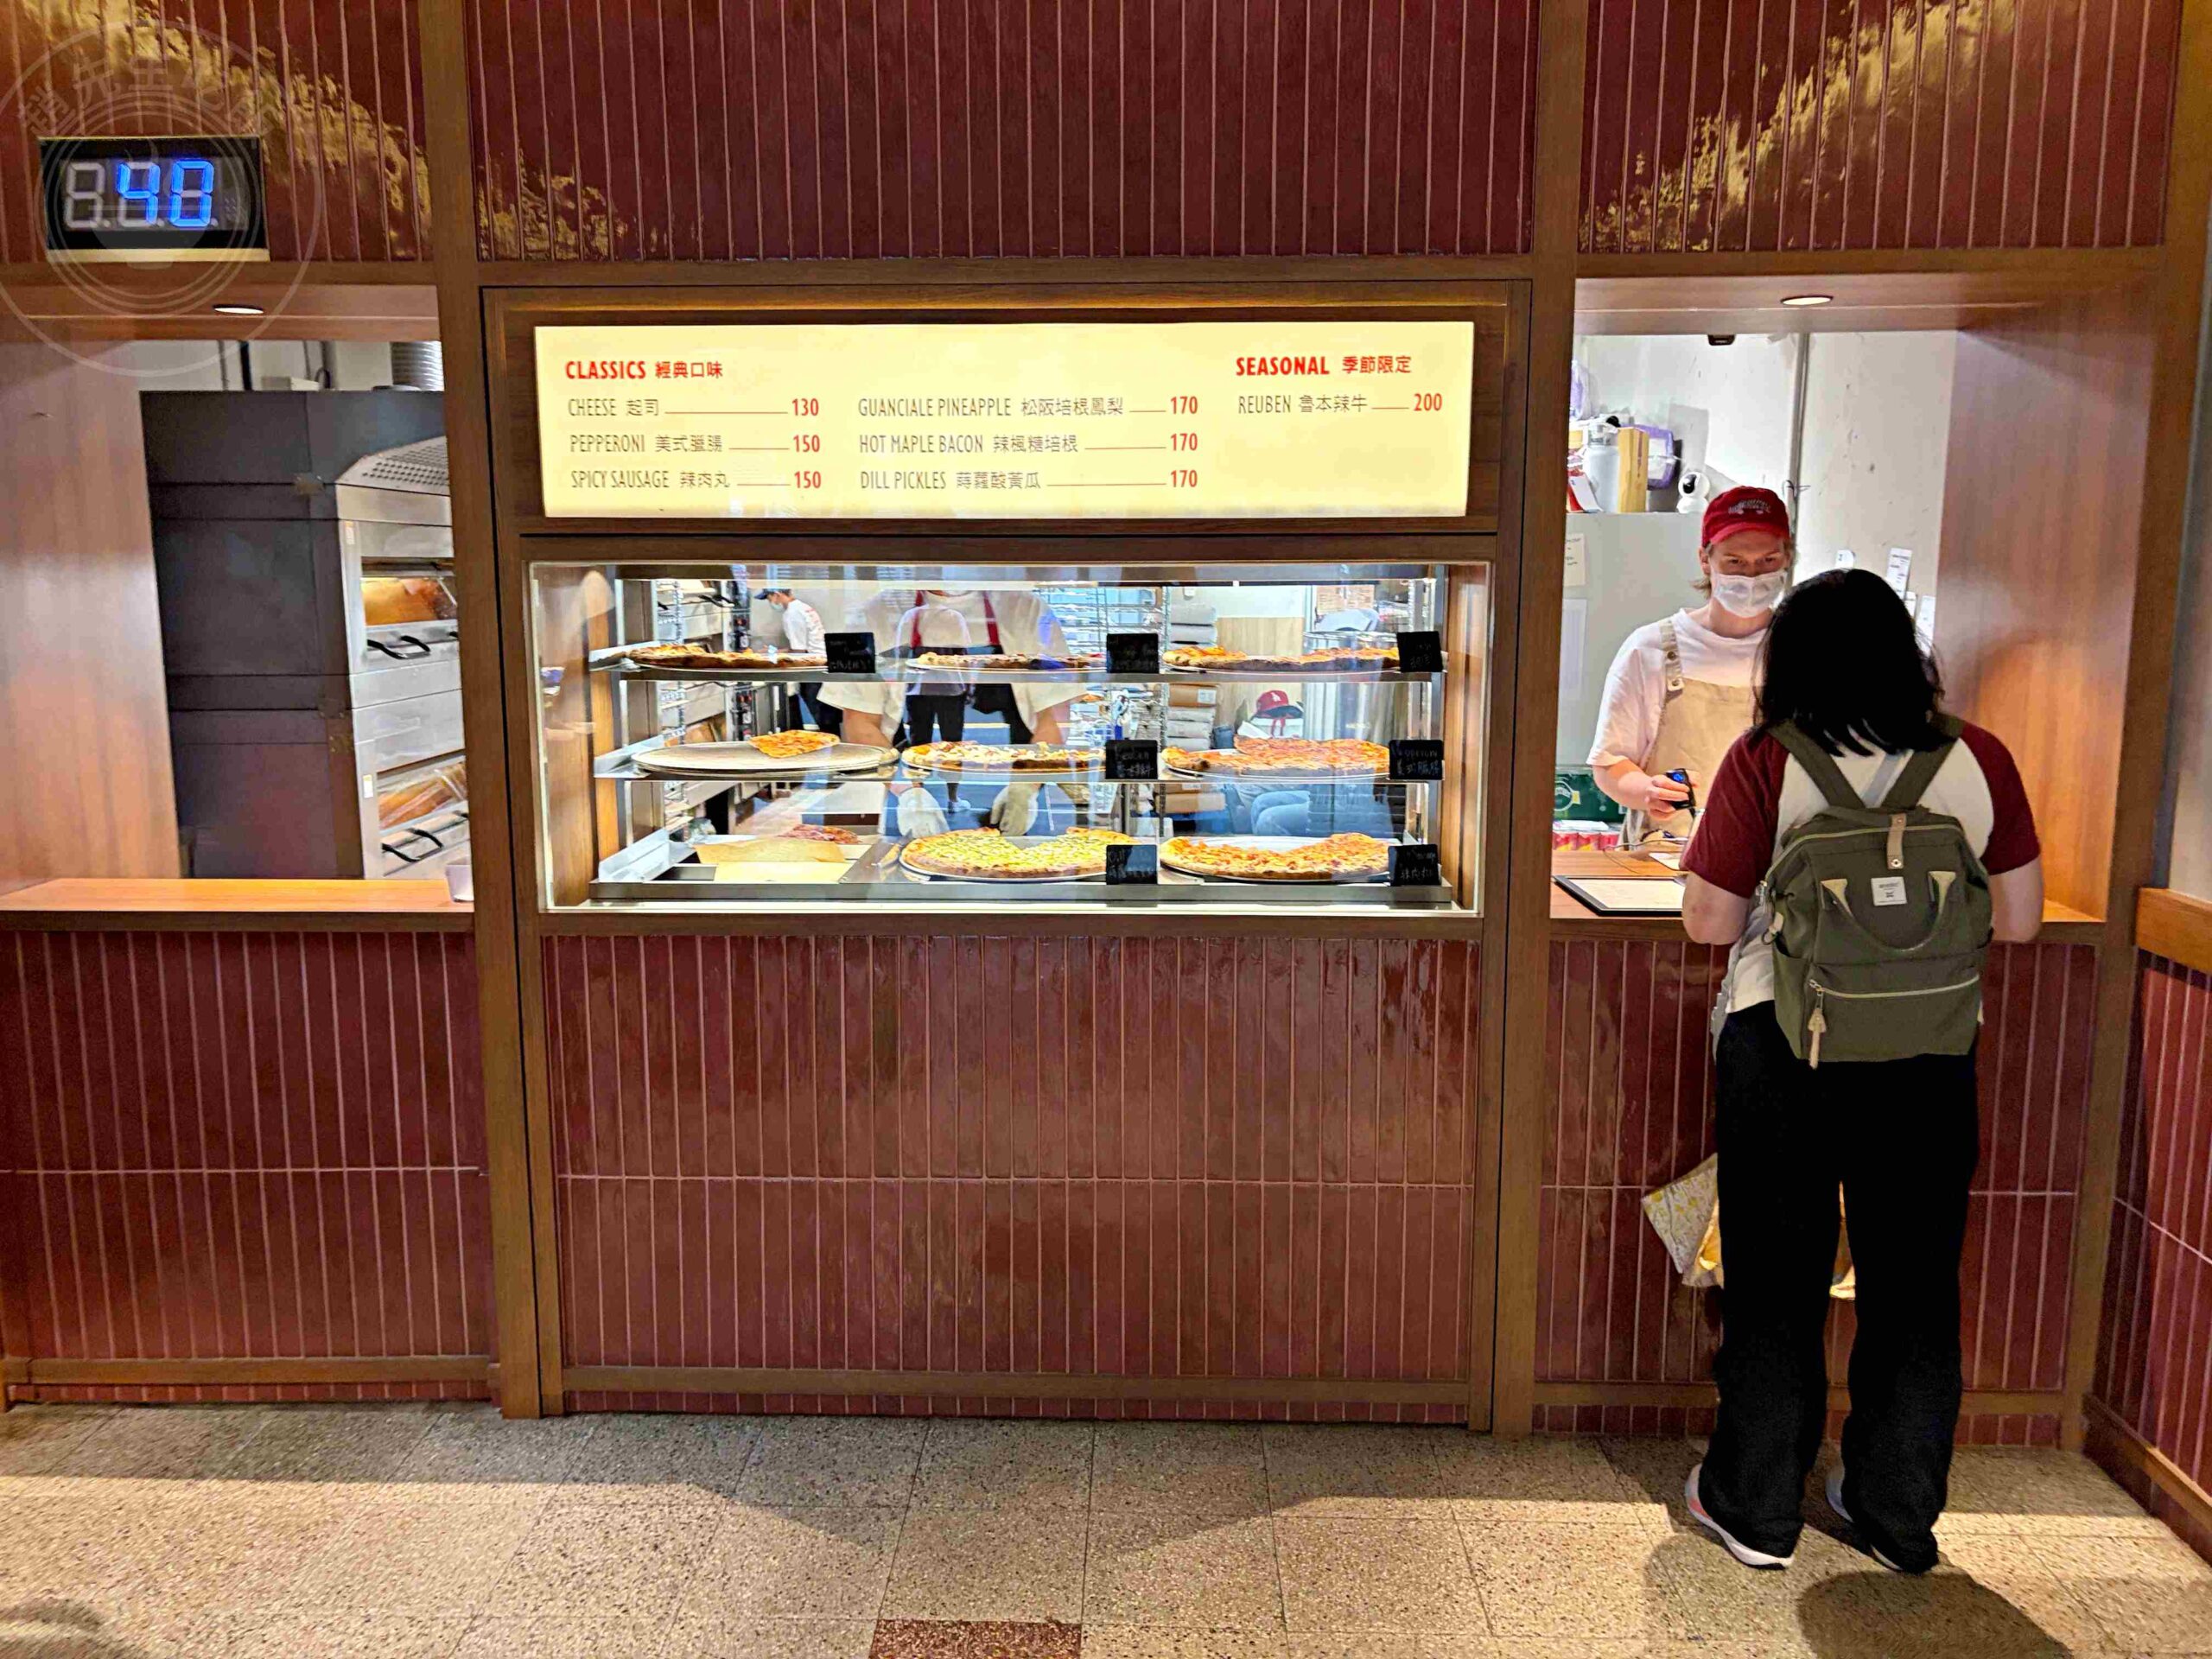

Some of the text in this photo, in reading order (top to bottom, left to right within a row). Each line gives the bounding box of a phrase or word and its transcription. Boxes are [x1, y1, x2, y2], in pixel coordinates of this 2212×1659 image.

[117, 158, 215, 228] 40
[564, 359, 723, 380] CLASSICS 經典口味
[1235, 354, 1412, 377] SEASONAL 季節限定
[568, 397, 820, 416] CHEESE 起司 130
[858, 395, 1198, 417] GUANCIALE PINEAPPLE 松阪培根鳳梨 170
[1238, 392, 1443, 414] REUBEN 魯本辣牛 200
[570, 434, 645, 453] PEPPERONI
[792, 434, 821, 453] 150
[859, 432, 1198, 454] HOT MAPLE BACON 辣楓糖培根 170
[571, 470, 822, 489] SPICY SAUSAGE 辣肉丸 150
[861, 471, 890, 489] DILL
[894, 471, 946, 490] PICKLES
[1170, 469, 1198, 488] 170
